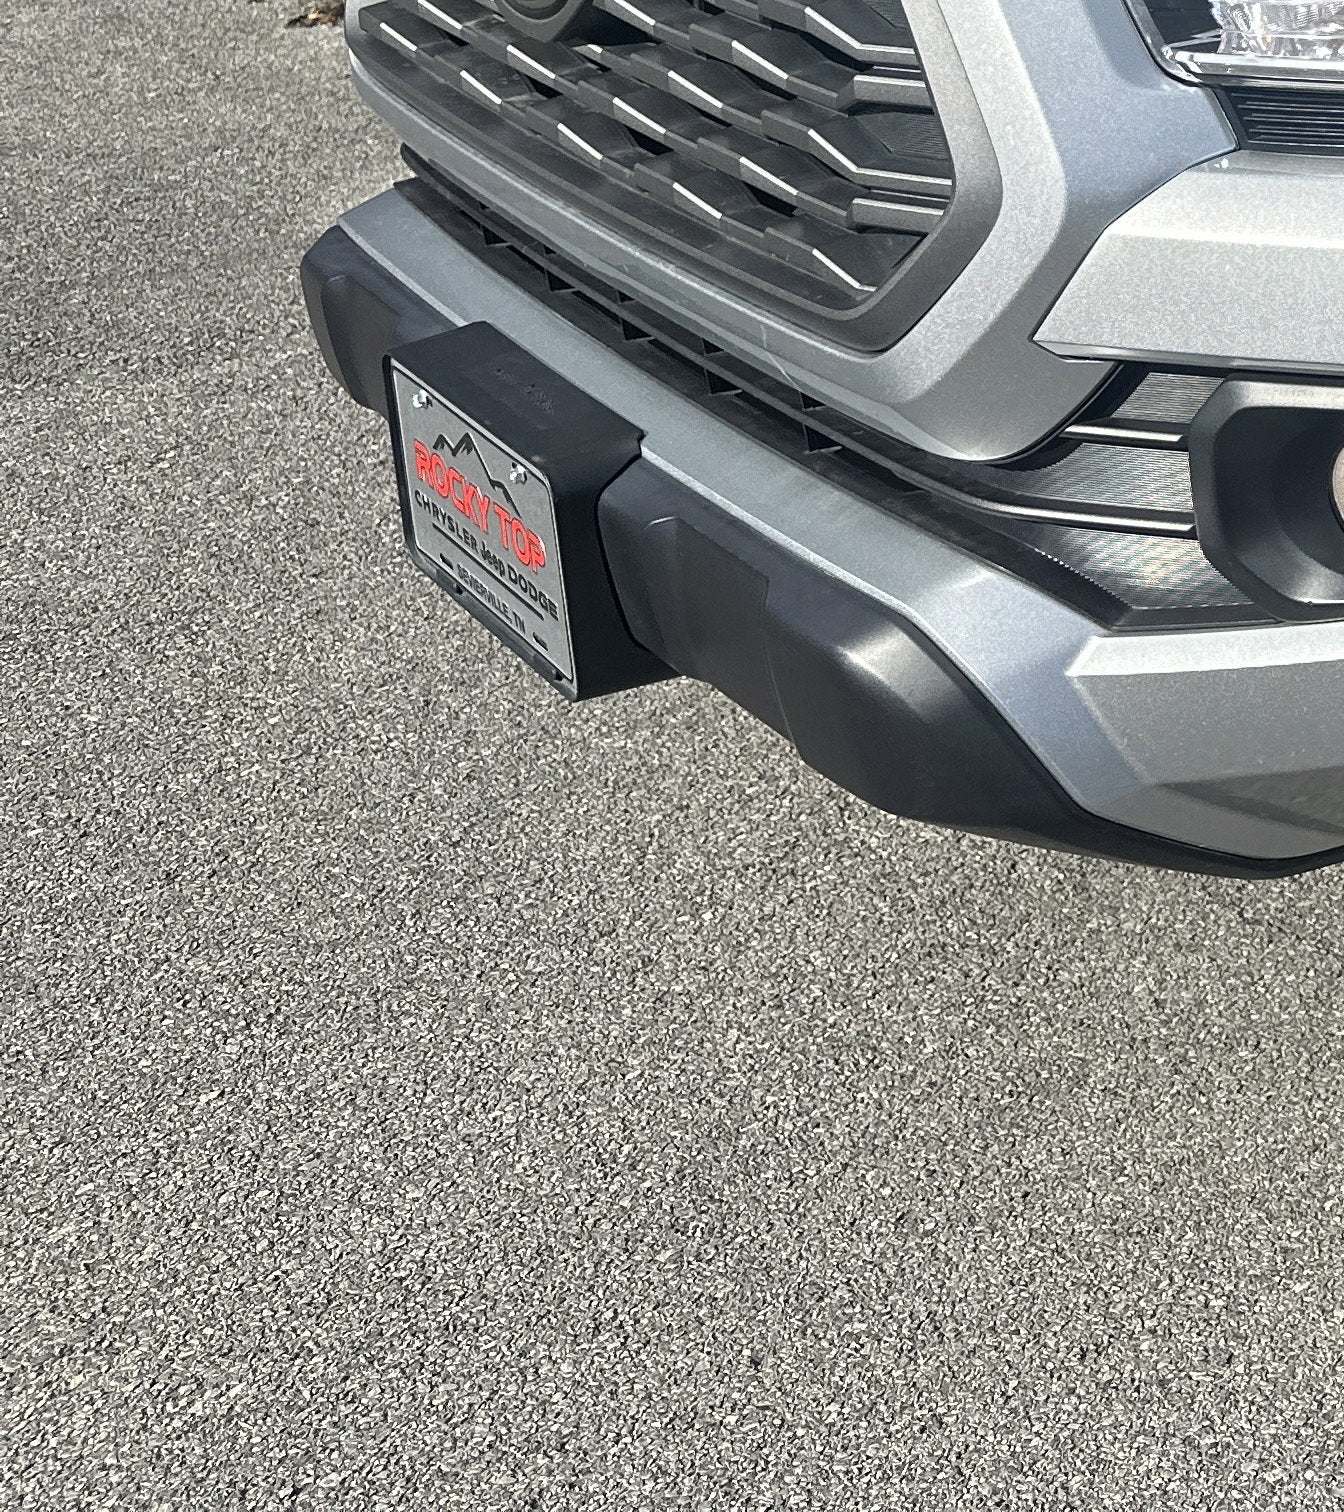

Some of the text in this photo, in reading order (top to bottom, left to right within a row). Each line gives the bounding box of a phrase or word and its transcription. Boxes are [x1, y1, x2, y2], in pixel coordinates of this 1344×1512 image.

[413, 438, 547, 575] ROCKY TOP
[414, 490, 559, 622] CHRYSLER Jeep DODGE
[512, 611, 526, 635] TN
